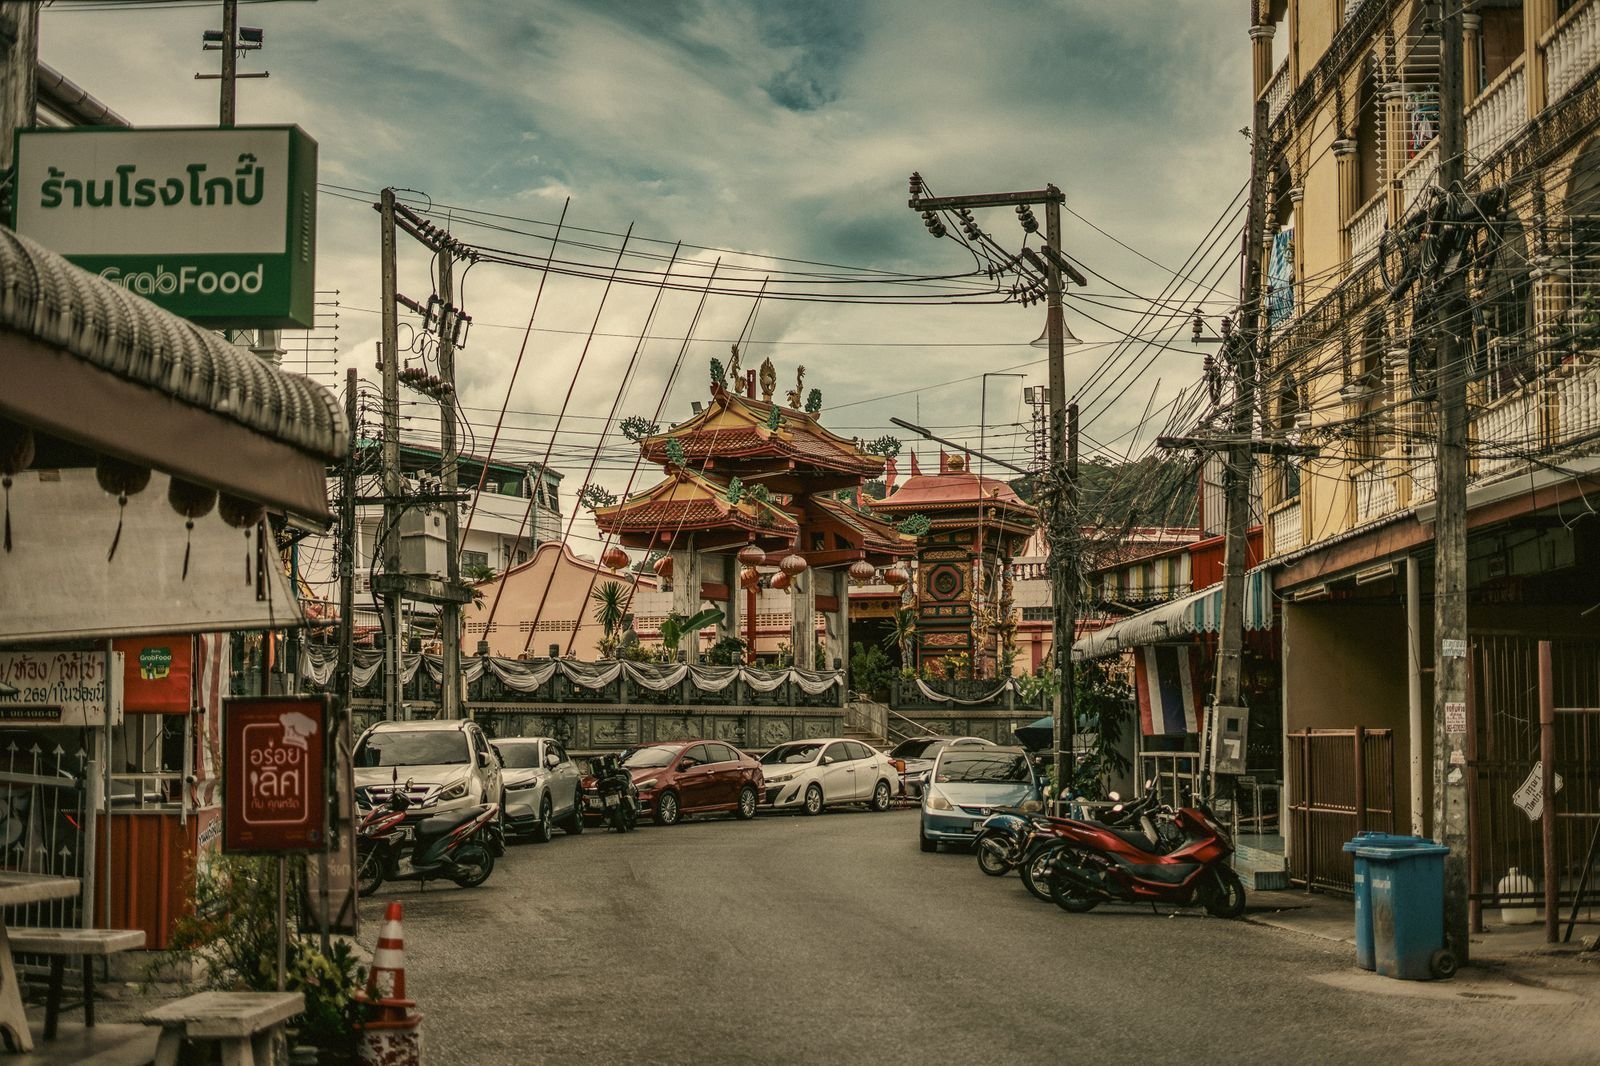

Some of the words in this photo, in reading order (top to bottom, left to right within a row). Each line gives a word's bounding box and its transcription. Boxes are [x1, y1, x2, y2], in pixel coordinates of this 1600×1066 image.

[40, 153, 264, 208] ร้านโรงโกปี๊
[250, 737, 300, 765] อร่อย
[1223, 738, 1240, 759] 7
